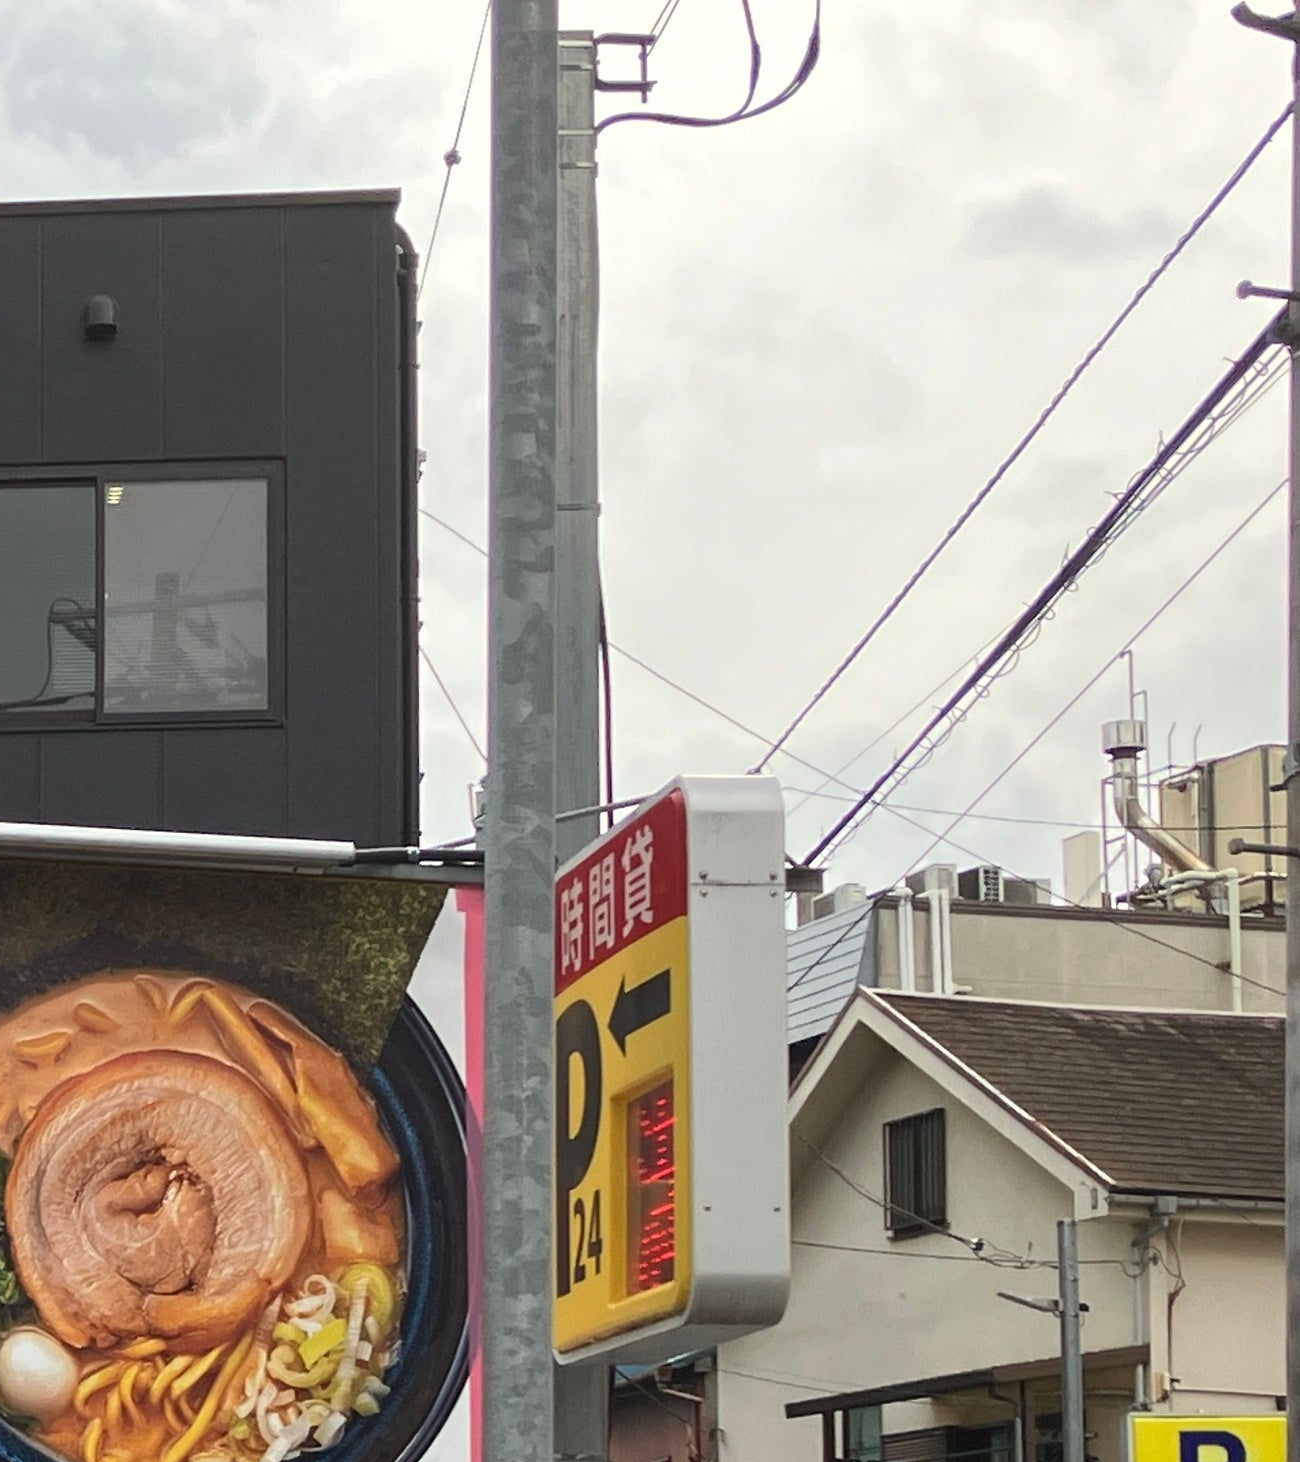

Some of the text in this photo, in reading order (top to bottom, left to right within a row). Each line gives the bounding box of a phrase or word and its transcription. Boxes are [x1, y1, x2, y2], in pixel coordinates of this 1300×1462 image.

[560, 823, 656, 977] 時間貸
[556, 998, 604, 1299] P 24
